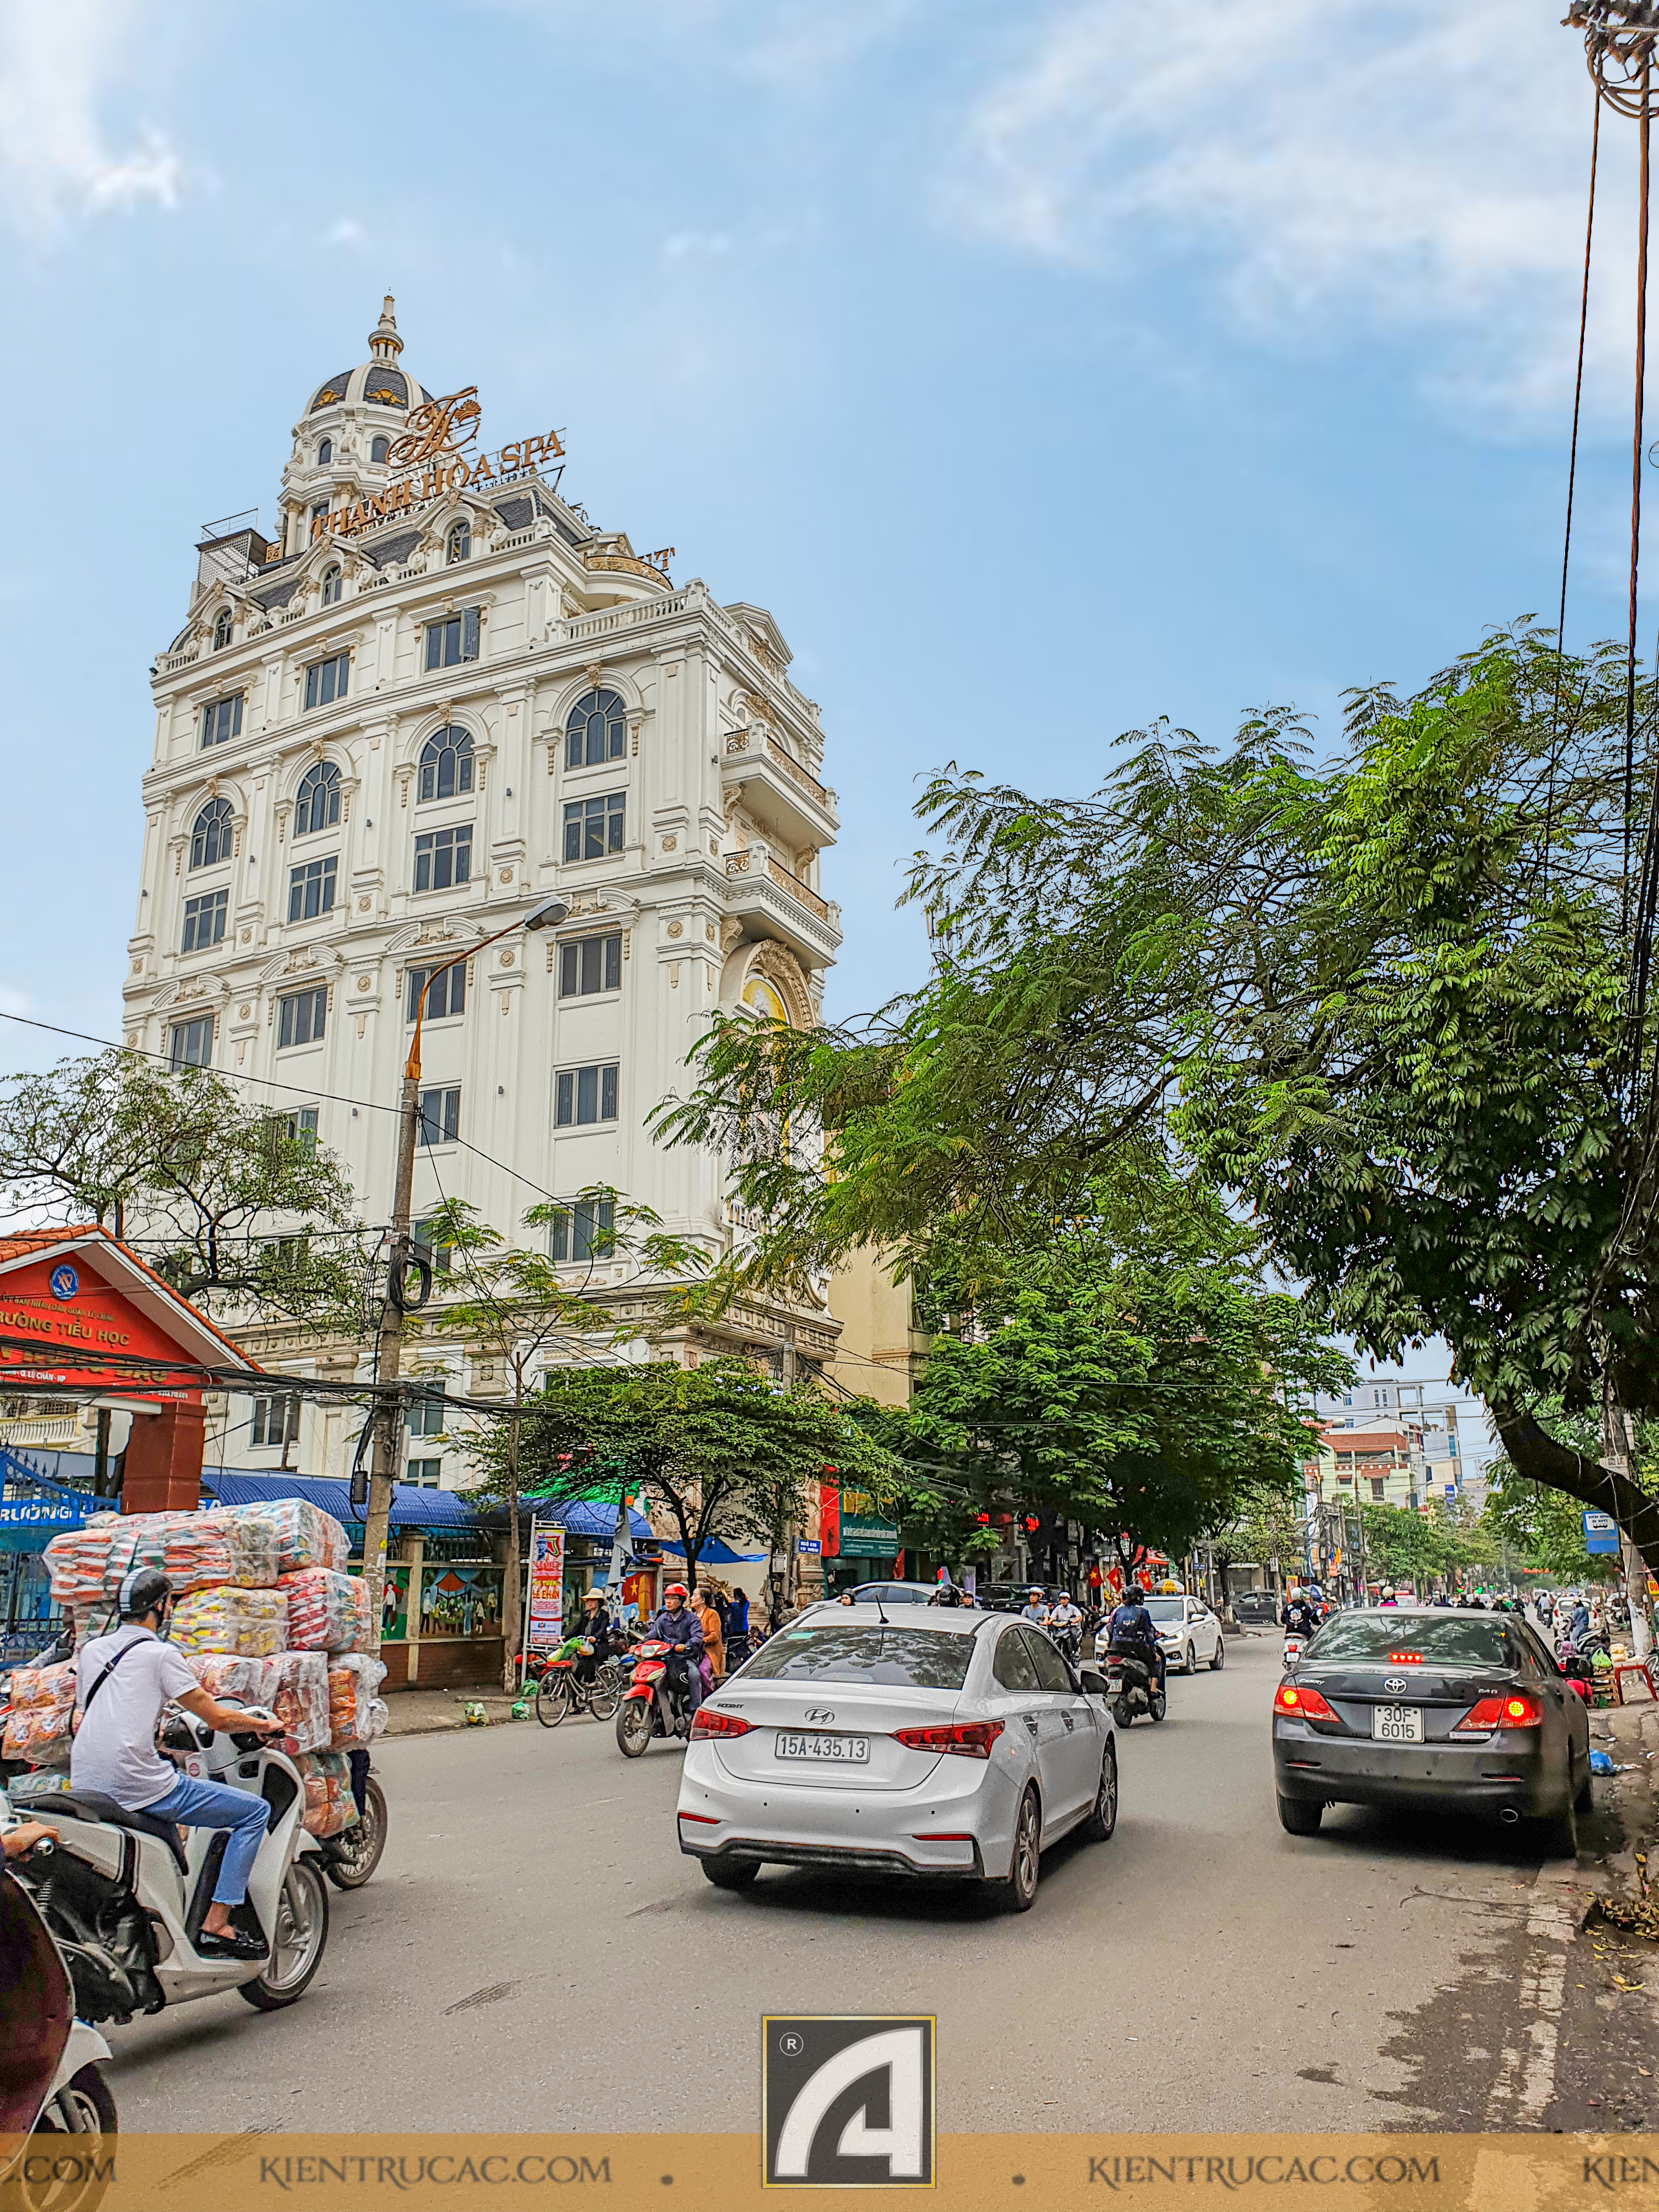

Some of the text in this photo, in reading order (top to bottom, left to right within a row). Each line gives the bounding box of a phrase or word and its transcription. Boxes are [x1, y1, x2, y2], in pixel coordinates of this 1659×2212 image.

[310, 479, 413, 540] THANH
[500, 430, 566, 475] SPA
[57, 1318, 92, 1339] TIỂU
[97, 1330, 129, 1348] HỌC
[1381, 1723, 1415, 1739] 6015
[781, 1736, 865, 1758] 15A-435.13
